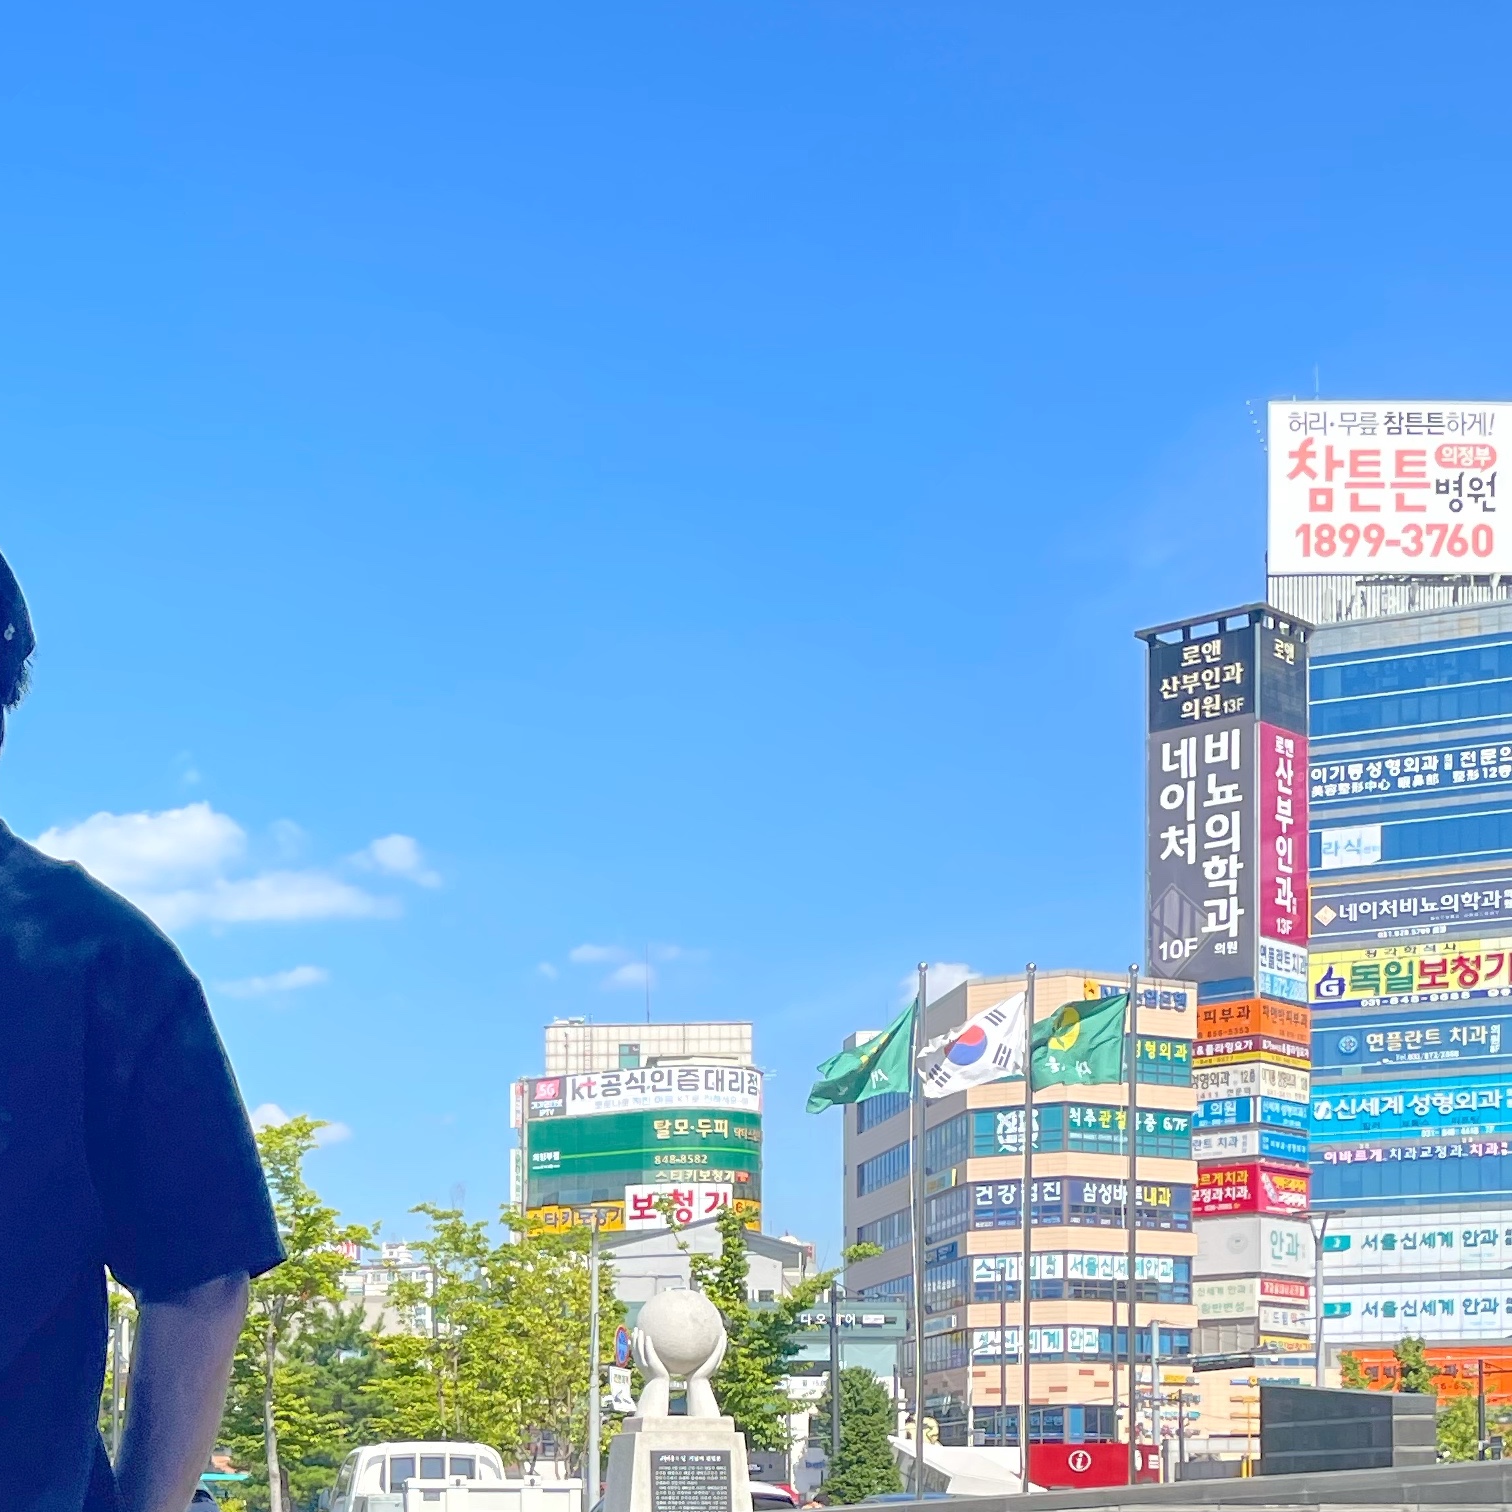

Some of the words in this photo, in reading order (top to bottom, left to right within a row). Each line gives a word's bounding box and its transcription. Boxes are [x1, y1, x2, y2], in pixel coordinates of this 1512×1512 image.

[1288, 411, 1380, 437] 허리·무릎
[1383, 411, 1496, 437] 참튼튼하게!
[1440, 446, 1492, 465] 의정부
[1286, 437, 1431, 513] 참튼튼
[1435, 471, 1497, 513] 병원
[1294, 523, 1495, 558] 1899-3760
[1180, 639, 1222, 668] 로앤
[1159, 663, 1244, 701] 산부인과
[1180, 697, 1222, 721] 의원
[1159, 736, 1197, 865] 네이처
[1201, 728, 1244, 938] 비뇨의학과
[1274, 759, 1295, 913] 산부인과
[1339, 889, 1503, 922] 네이처비뇨의학과
[1159, 937, 1198, 961] 10F
[1214, 940, 1238, 955] 의원
[1349, 952, 1512, 997] 독일보청기
[1198, 1005, 1251, 1024] 피부과
[1365, 1029, 1442, 1053] 연플란트
[1449, 1025, 1488, 1047] 치과
[1333, 1094, 1404, 1120] 신세계
[1405, 1088, 1504, 1117] 성형외과
[653, 1118, 729, 1140] 탈모·두피
[628, 1188, 729, 1224] 보청기
[1269, 1229, 1301, 1262] 안과
[1360, 1230, 1455, 1252] 서울신세계
[1462, 1228, 1499, 1248] 안과
[1360, 1299, 1455, 1318] 서울신세계
[1462, 1296, 1499, 1316] 안과
